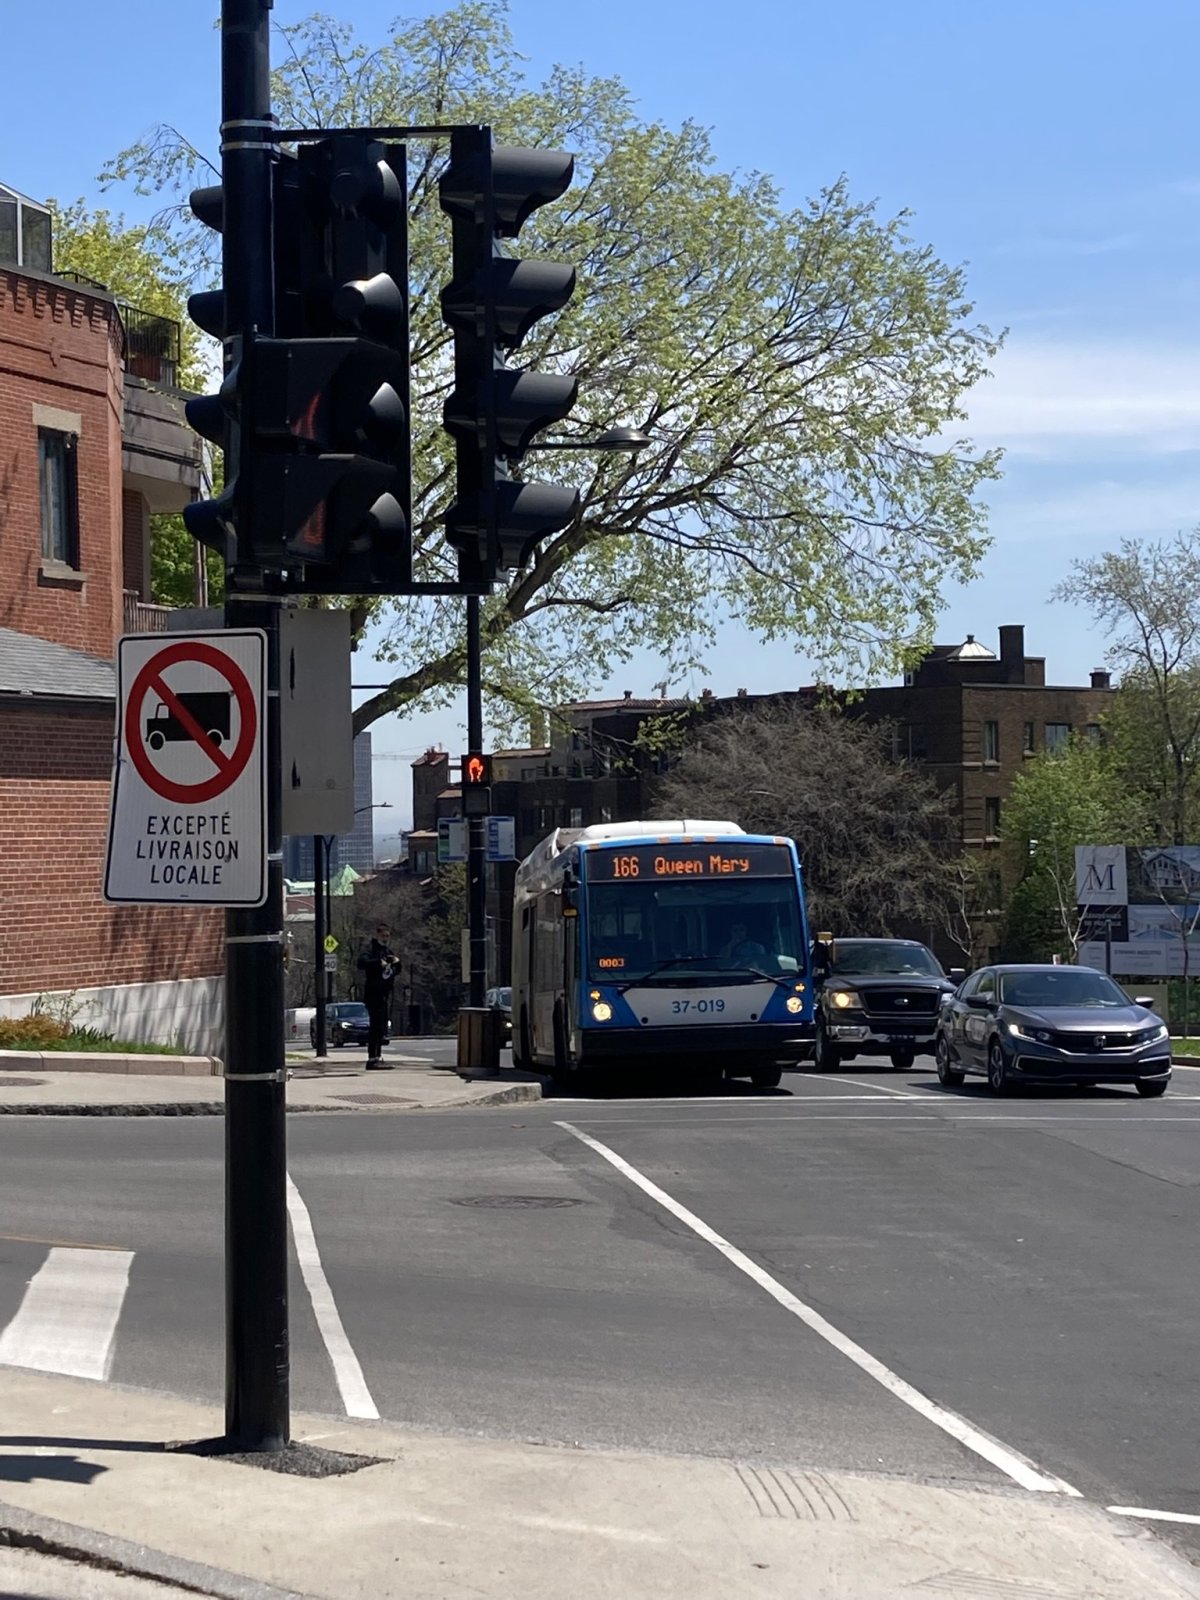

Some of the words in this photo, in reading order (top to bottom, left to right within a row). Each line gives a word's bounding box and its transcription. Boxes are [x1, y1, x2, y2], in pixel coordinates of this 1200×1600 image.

[147, 812, 231, 834] EXCEPTÉ
[136, 840, 238, 859] LIVRAISON
[150, 865, 221, 884] LOCALE
[612, 856, 640, 877] 166
[654, 857, 703, 874] Queen
[709, 855, 750, 873] Mary
[1086, 864, 1116, 890] M
[672, 1000, 725, 1013] 37-019
